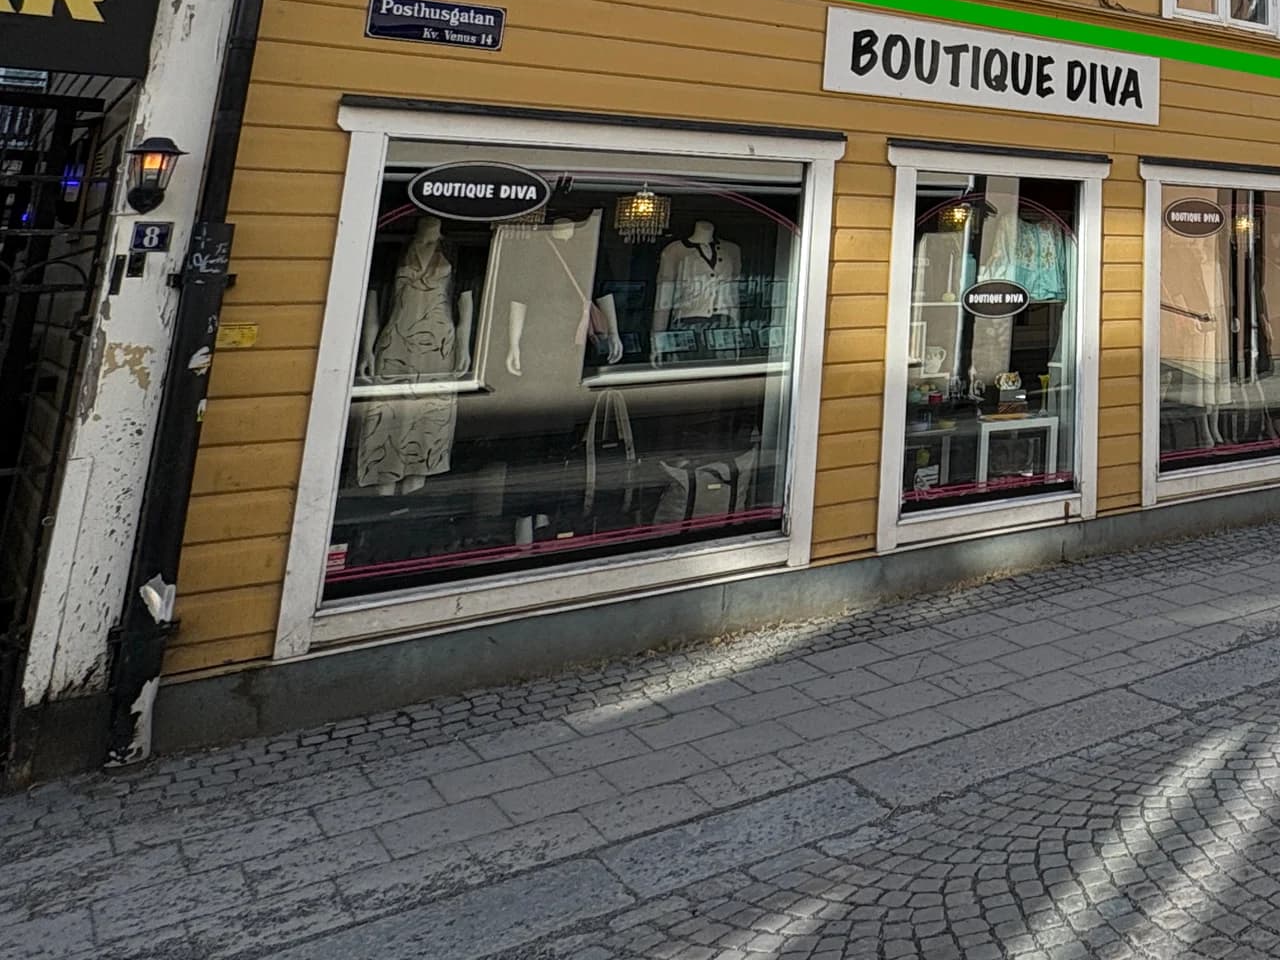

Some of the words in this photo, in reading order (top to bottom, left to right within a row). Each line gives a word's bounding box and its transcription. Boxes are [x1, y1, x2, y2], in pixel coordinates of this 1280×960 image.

[444, 29, 477, 44] Venus
[479, 33, 493, 46] 14
[850, 28, 1056, 99] BOUTIQUE
[1066, 59, 1143, 109] DIVA
[422, 181, 494, 199] BOUTIQUE
[500, 185, 537, 200] DIVA
[1171, 211, 1202, 223] BOUTIQUE
[1203, 212, 1221, 223] DIVA
[142, 225, 160, 248] 8
[968, 293, 1003, 304] BOUTIQUE
[1005, 293, 1024, 304] DIVA
